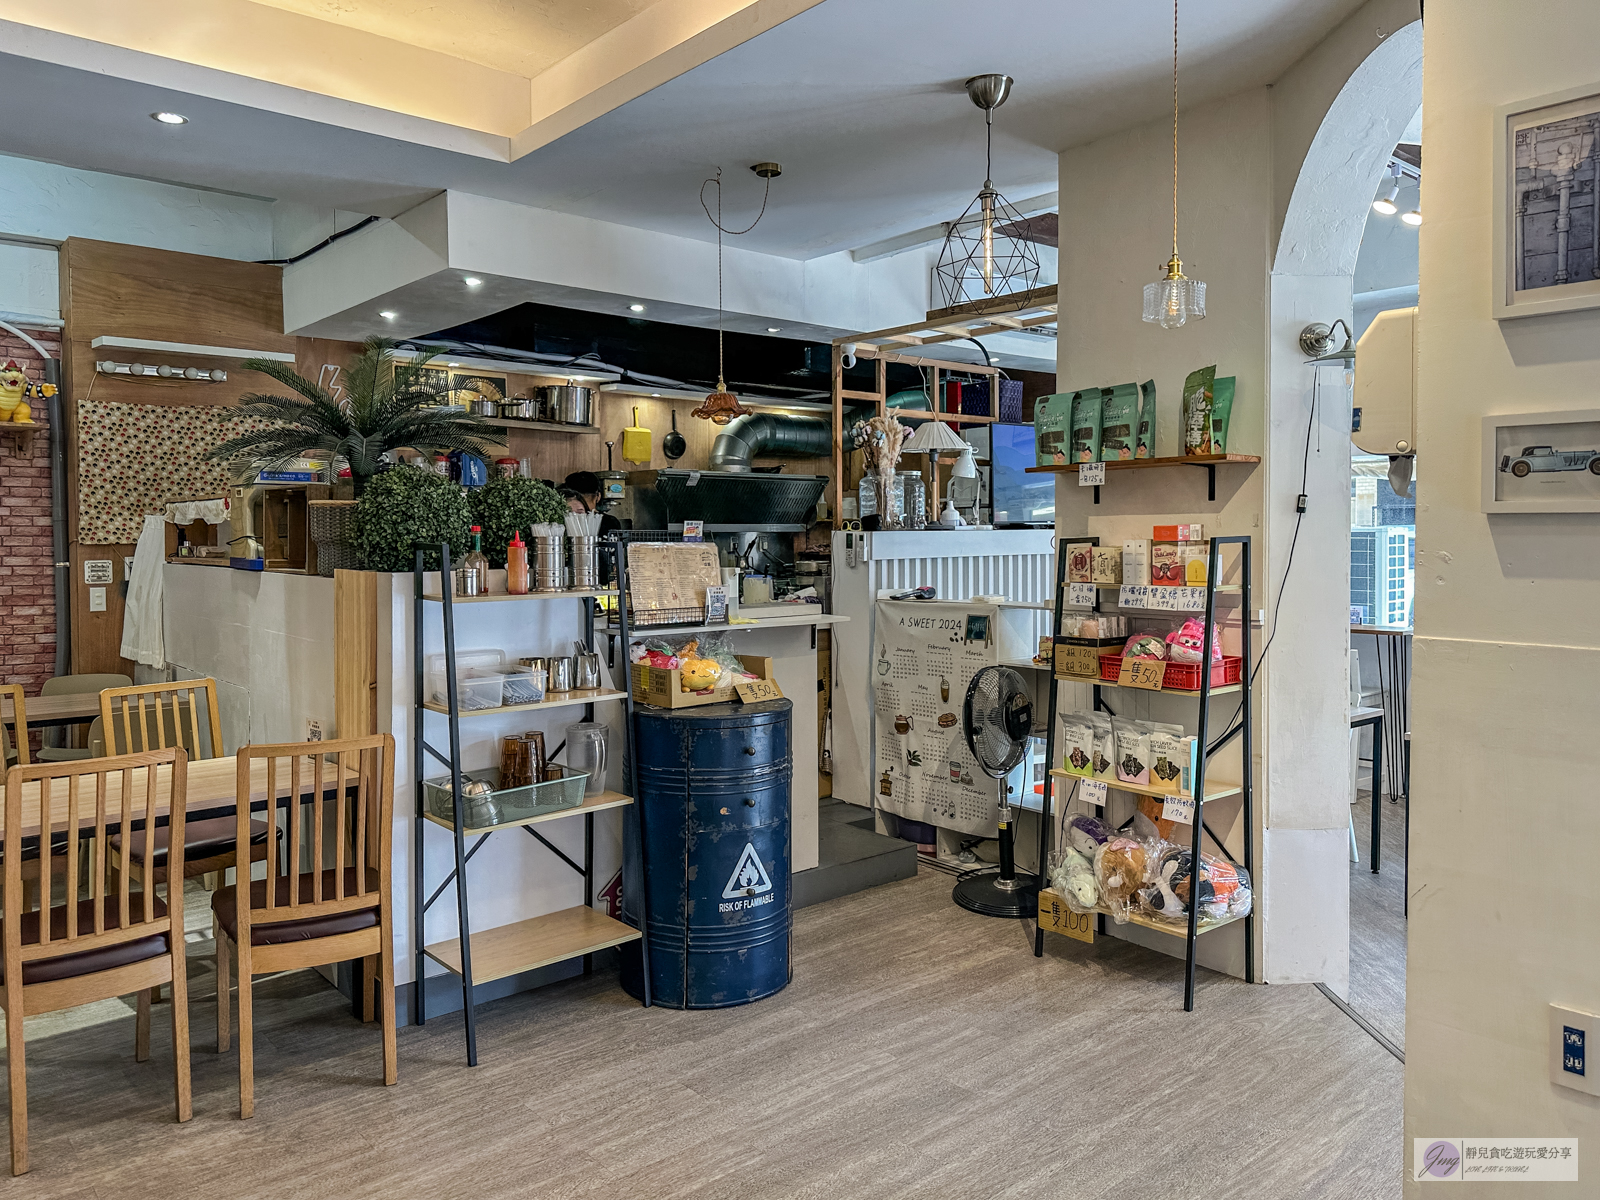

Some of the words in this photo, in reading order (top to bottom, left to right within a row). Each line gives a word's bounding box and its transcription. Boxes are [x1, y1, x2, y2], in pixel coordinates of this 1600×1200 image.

[899, 617, 905, 626] A
[907, 616, 936, 629] SWEET
[938, 618, 962, 630] 2024
[895, 646, 915, 655] January
[927, 643, 952, 653] February
[962, 786, 987, 796] December
[718, 903, 734, 913] RISK
[734, 901, 743, 911] OF
[743, 893, 775, 909] FLAMMABLE
